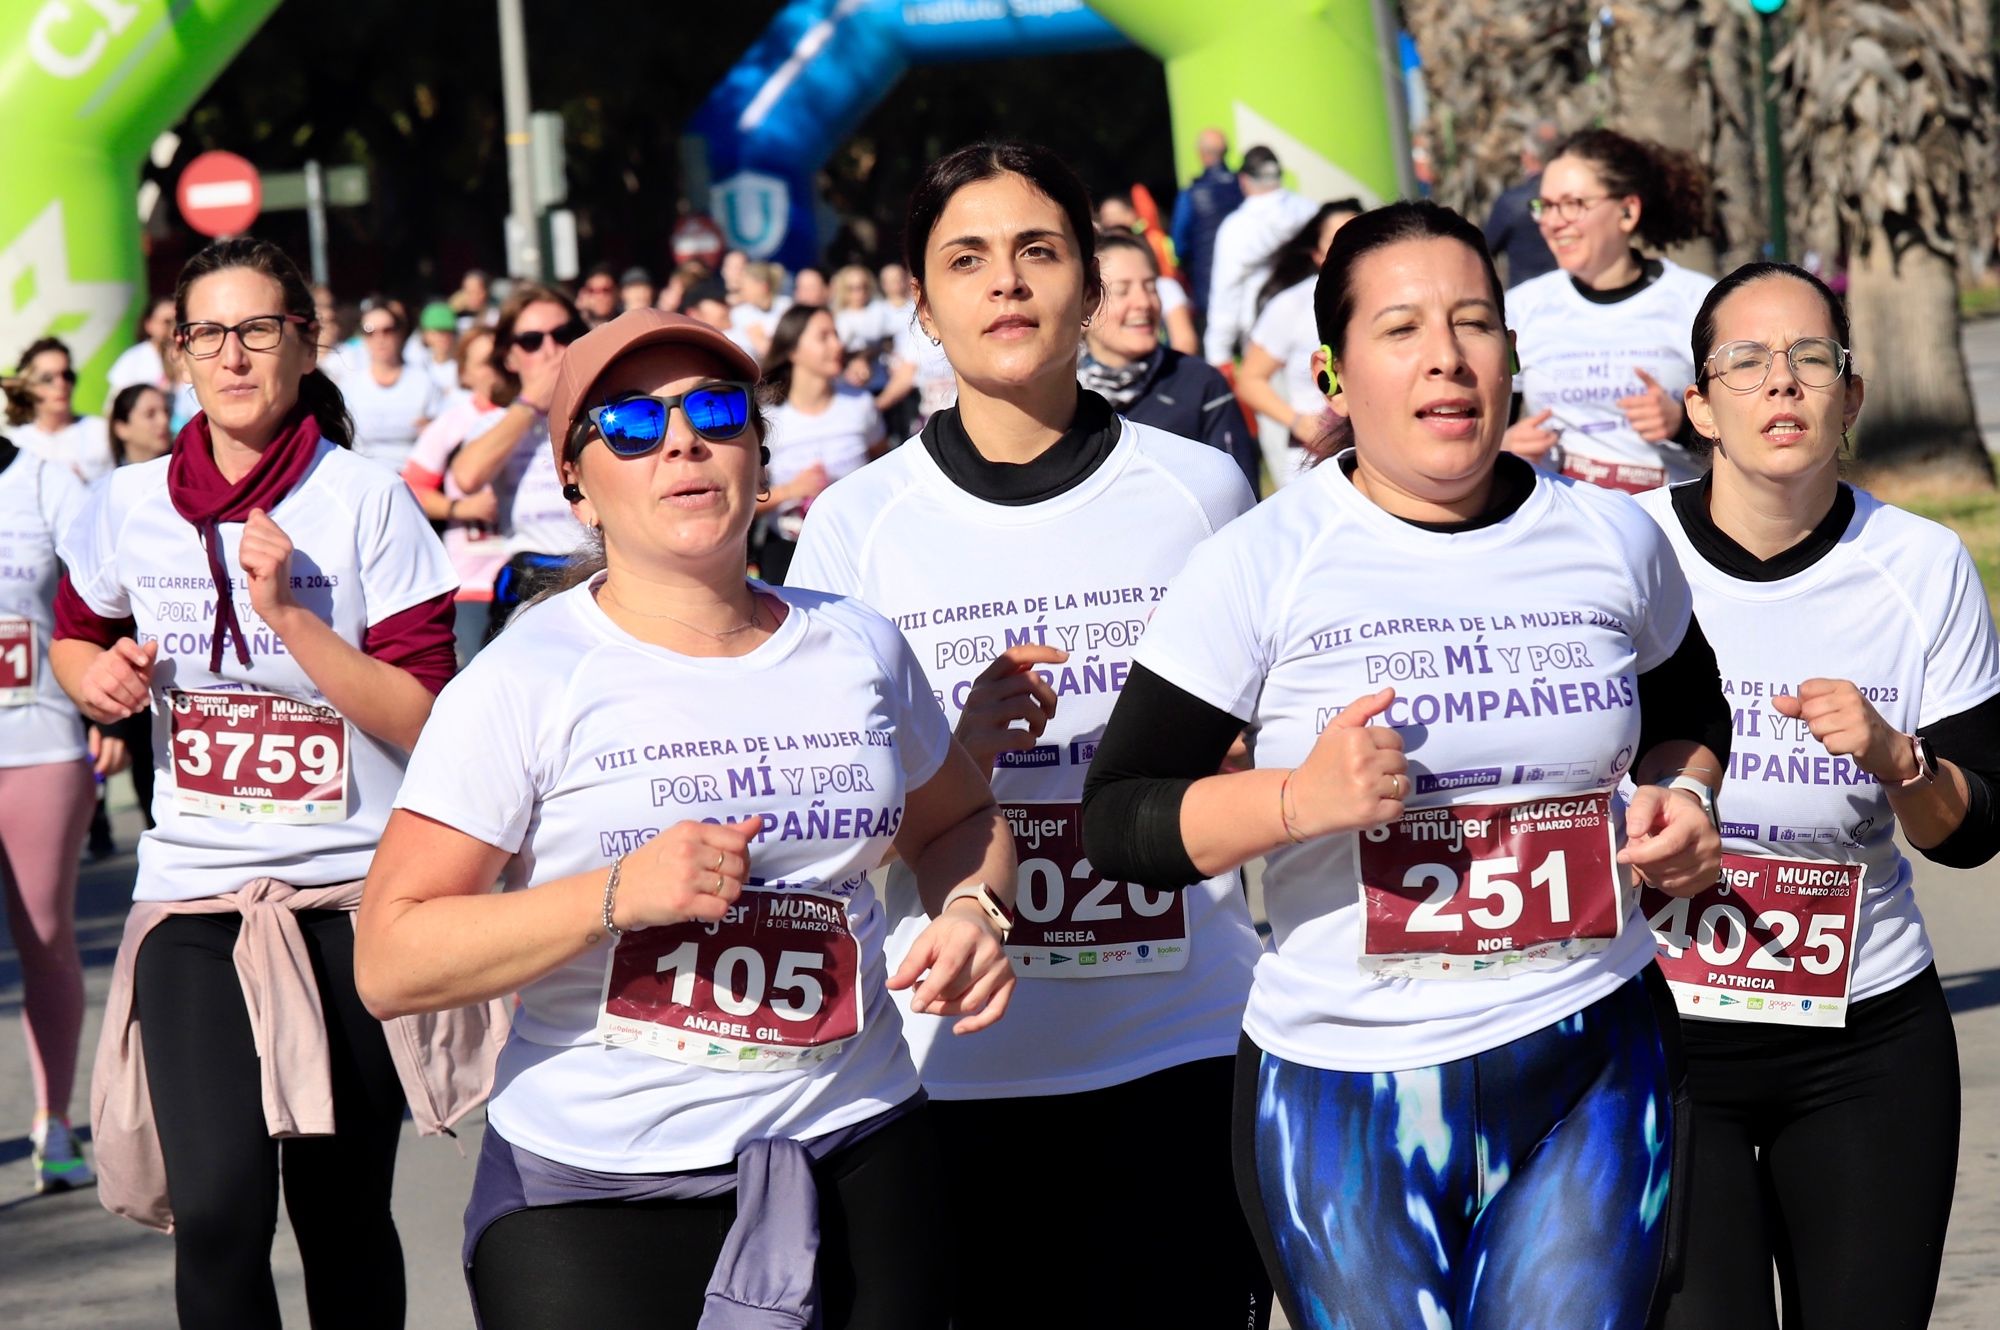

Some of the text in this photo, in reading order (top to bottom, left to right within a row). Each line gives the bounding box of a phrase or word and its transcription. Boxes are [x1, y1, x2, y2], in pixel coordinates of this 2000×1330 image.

[137, 577, 155, 588] VIII
[159, 576, 214, 590] CARRERA
[307, 575, 339, 588] 2023
[157, 602, 196, 622] POR
[933, 600, 1017, 624] CARRERA
[1024, 597, 1048, 613] DE
[1055, 594, 1078, 609] LA
[1084, 587, 1143, 607] MUJER
[936, 615, 1145, 669] POR MÍ Y POR
[1311, 628, 1353, 652] VIII
[1359, 616, 1455, 640] CARRERA
[1461, 616, 1486, 632] DE
[1491, 614, 1516, 631] LA
[1521, 611, 1583, 629] MUJER
[1366, 635, 1594, 684] POR MÍ Y POR
[193, 695, 229, 704] carrera
[1741, 681, 1763, 696] DE
[1770, 683, 1790, 697] LA
[1384, 676, 1635, 728] COMPAÑERAS
[203, 704, 259, 727] mujer
[1769, 715, 1789, 740] Y
[176, 729, 339, 785] 3759
[595, 729, 892, 771] VIII CARRERA DE LA MUJER 2023
[233, 786, 273, 798] LAURA
[651, 755, 874, 807] POR MÍ Y POR
[1511, 800, 1598, 822] MURCIA
[1412, 819, 1492, 853] mujer
[1511, 816, 1600, 835] 5 DE MARZO 2023
[1777, 866, 1850, 886] MURCIA
[1402, 850, 1570, 933] 251
[1775, 885, 1850, 897] 5 DE MARZO 2023
[769, 899, 841, 924] MURCIA
[767, 919, 774, 927] 5
[776, 920, 789, 928] DE
[791, 920, 828, 931] MARZO
[1044, 931, 1096, 942] NEREA
[1649, 897, 1846, 975] 4025
[1477, 937, 1513, 951] NOE
[656, 941, 824, 1021] 105
[1708, 972, 1775, 990] PATRICIA
[683, 1015, 783, 1042] ANABEL GIL
